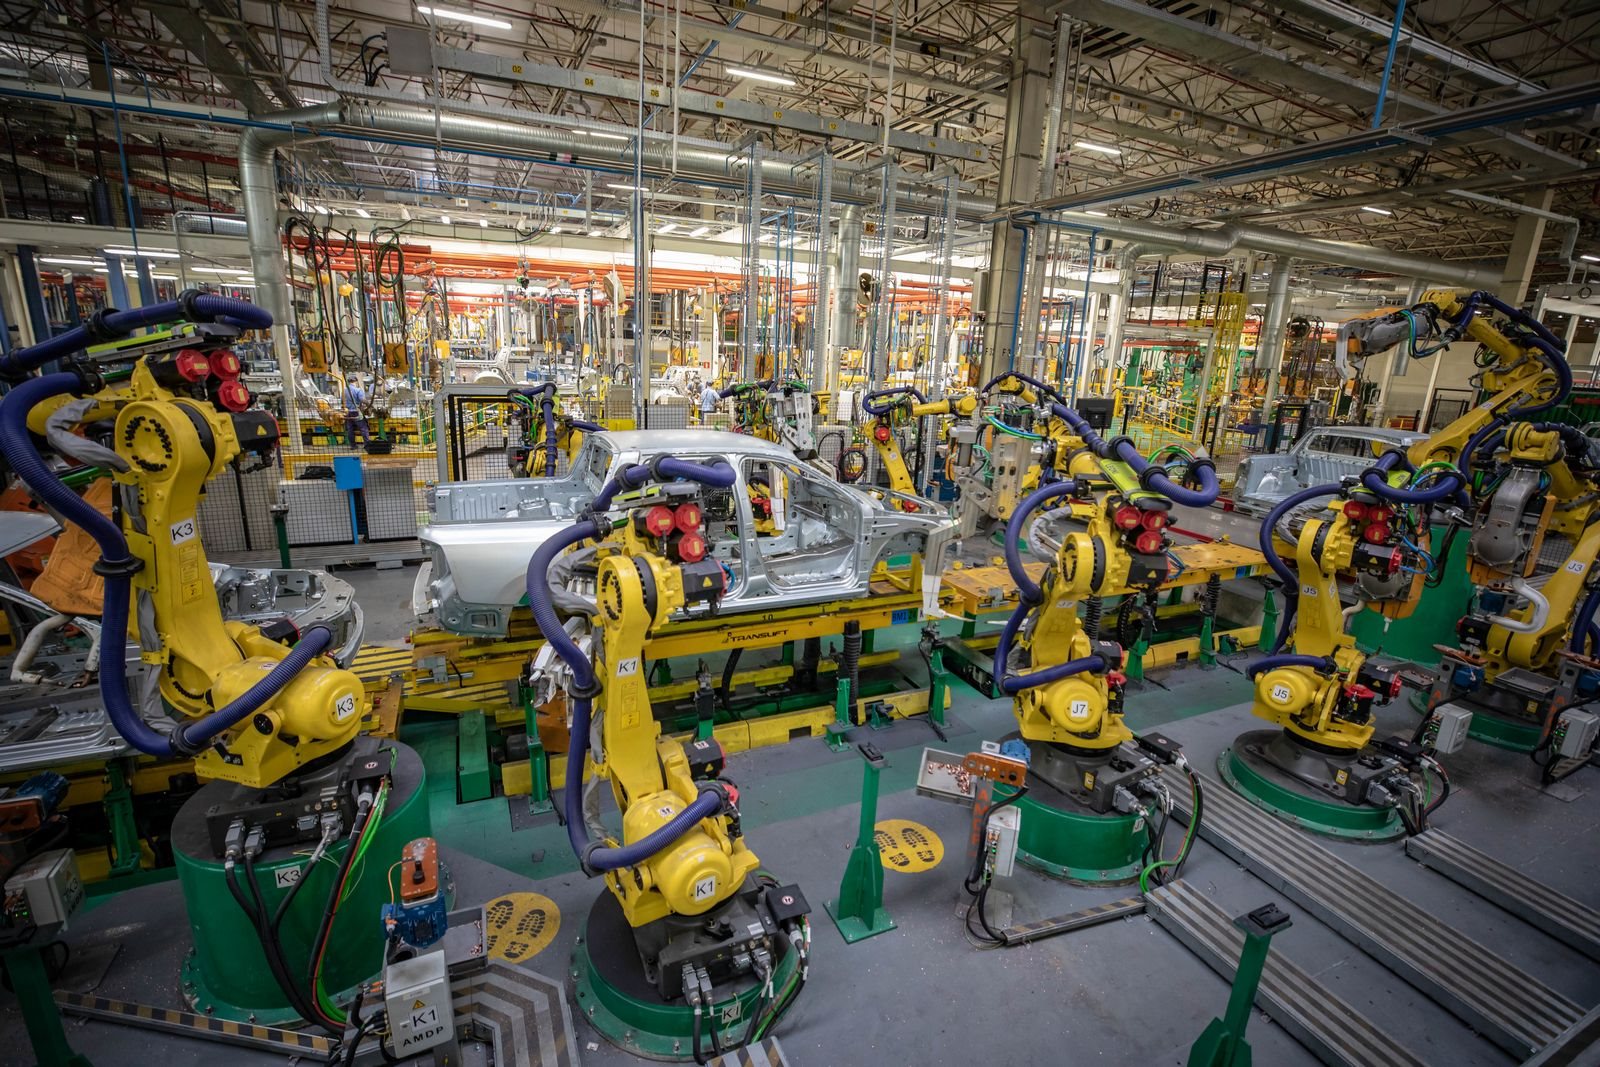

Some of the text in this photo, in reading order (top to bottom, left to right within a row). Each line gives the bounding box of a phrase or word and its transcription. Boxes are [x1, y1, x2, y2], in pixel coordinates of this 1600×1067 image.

[512, 65, 522, 73] 02
[585, 78, 594, 86] 04
[650, 89, 660, 97] 06
[775, 111, 782, 119] 10
[172, 523, 194, 541] K3
[1568, 563, 1582, 572] J3
[1304, 587, 1316, 595] J5
[731, 629, 789, 643] TRANSLIFT
[619, 660, 637, 673] K1
[1274, 689, 1287, 699] J5
[337, 697, 354, 716] K3
[1072, 704, 1086, 715] J7
[277, 870, 301, 884] K3
[696, 880, 713, 897] K1
[723, 1002, 739, 1020] K1
[412, 1009, 436, 1027] K1
[403, 1026, 444, 1047] AMDP
